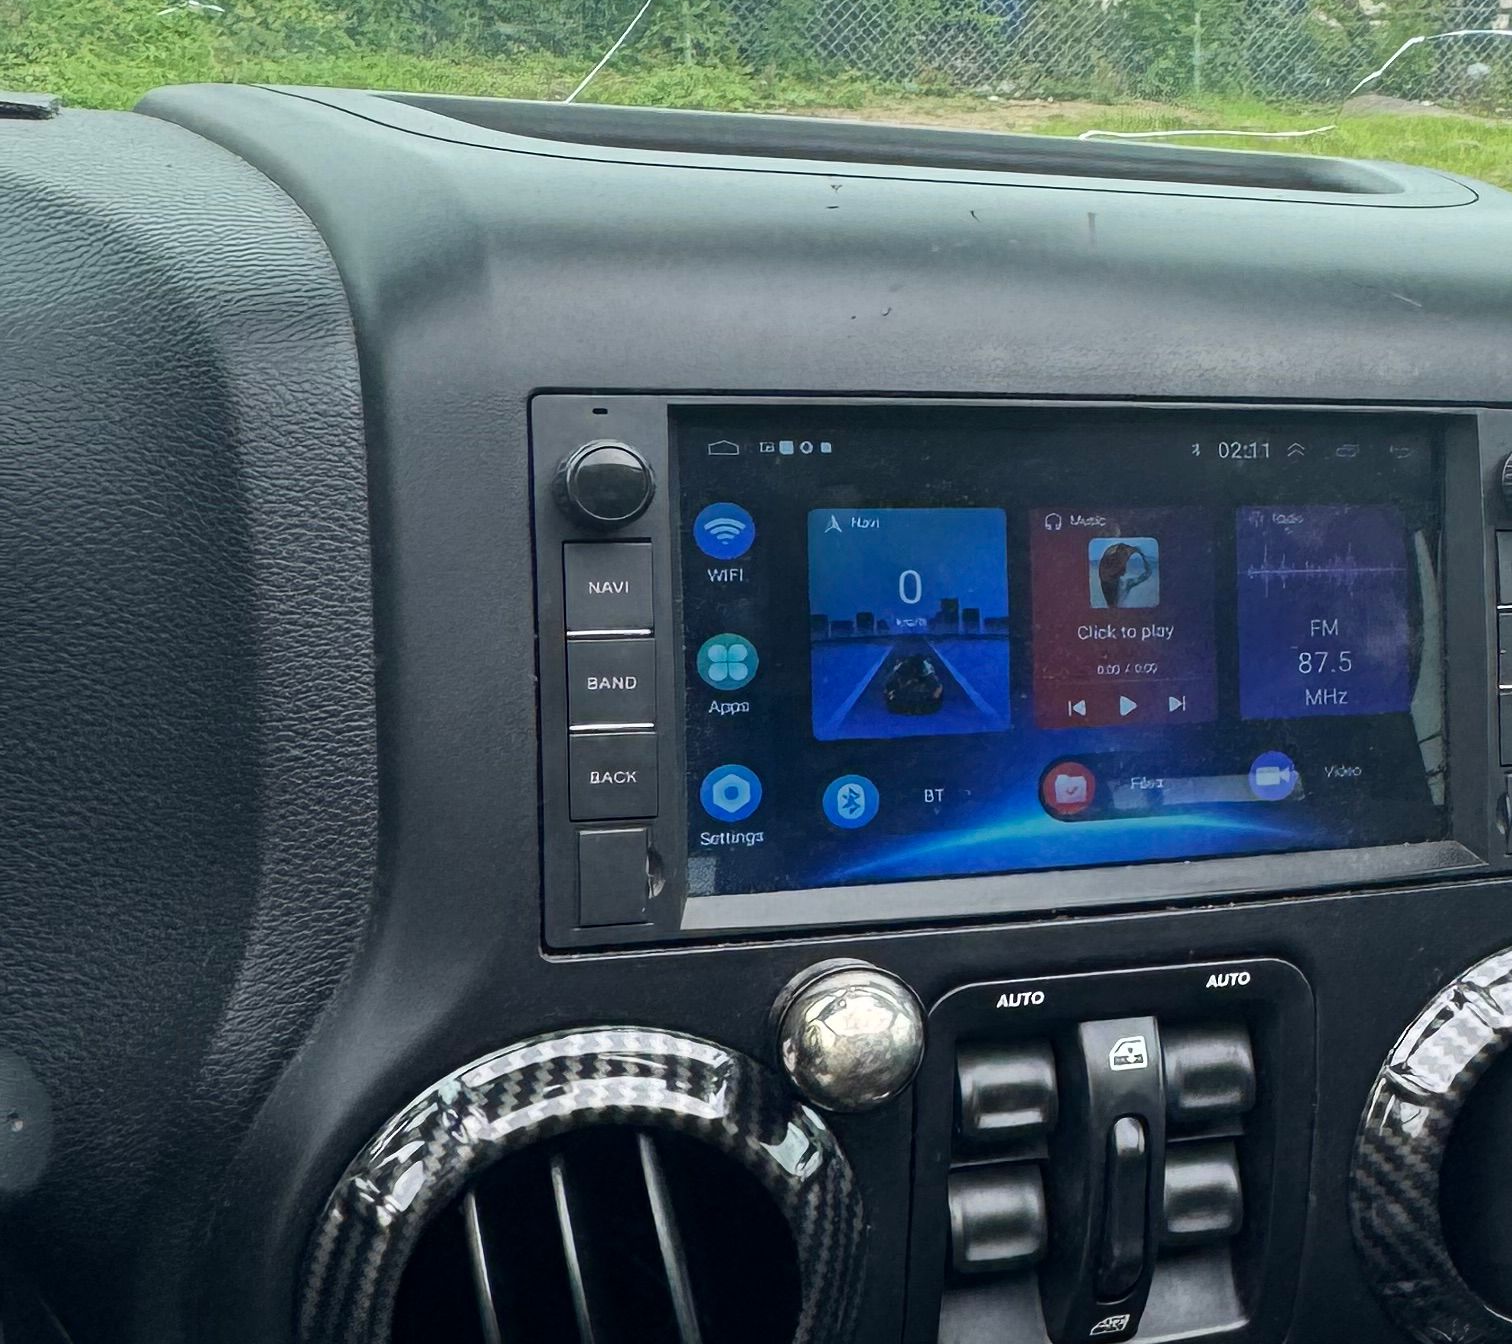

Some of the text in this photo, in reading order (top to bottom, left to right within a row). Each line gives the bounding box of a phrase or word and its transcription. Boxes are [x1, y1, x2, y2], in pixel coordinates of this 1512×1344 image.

[706, 567, 744, 584] WIFI
[588, 580, 630, 595] NAVI
[898, 569, 923, 605] 0
[1077, 624, 1175, 642] Click to play
[1310, 618, 1339, 637] FM
[1298, 650, 1353, 675] 87.5
[586, 676, 638, 691] BAND
[1304, 687, 1350, 707] MHz
[708, 699, 751, 716] Apps
[589, 770, 638, 786] BACK
[923, 787, 946, 804] BT
[699, 829, 765, 848] Settings
[1205, 971, 1251, 989] AUTO
[997, 991, 1045, 1009] AUTO
